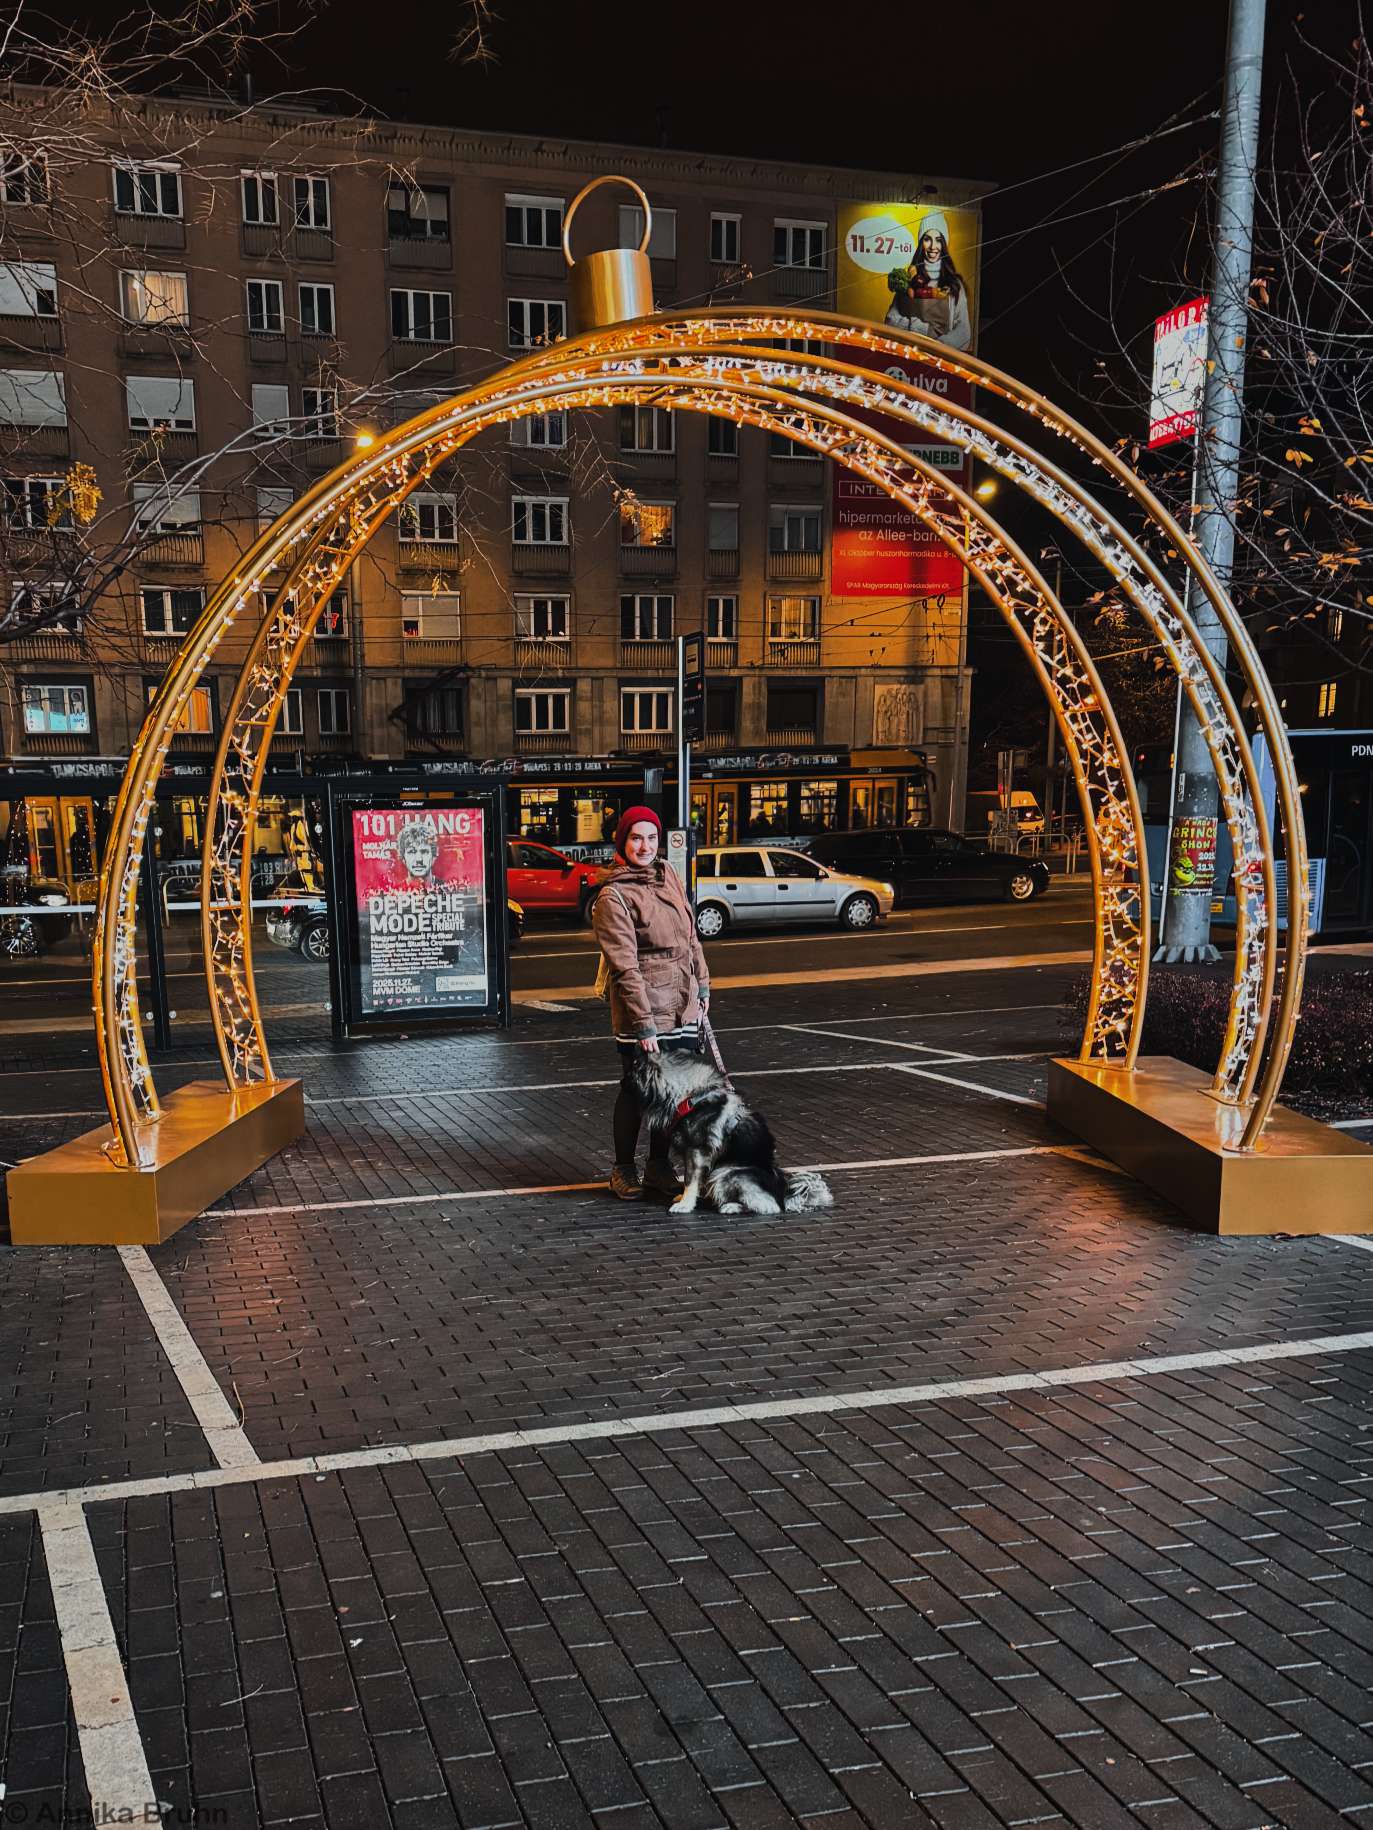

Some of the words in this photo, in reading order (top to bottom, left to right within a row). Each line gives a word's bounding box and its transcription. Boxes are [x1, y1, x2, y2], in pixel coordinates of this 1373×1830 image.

[851, 234, 871, 254] 11.
[858, 532, 873, 541] az
[361, 814, 396, 836] 101
[1181, 840, 1211, 849] SHOW
[369, 893, 465, 915] DEPECHE
[431, 911, 465, 921] SPECIAL
[370, 912, 431, 934] MODE
[431, 920, 466, 931] TRIBUTE
[372, 986, 395, 996] MVM
